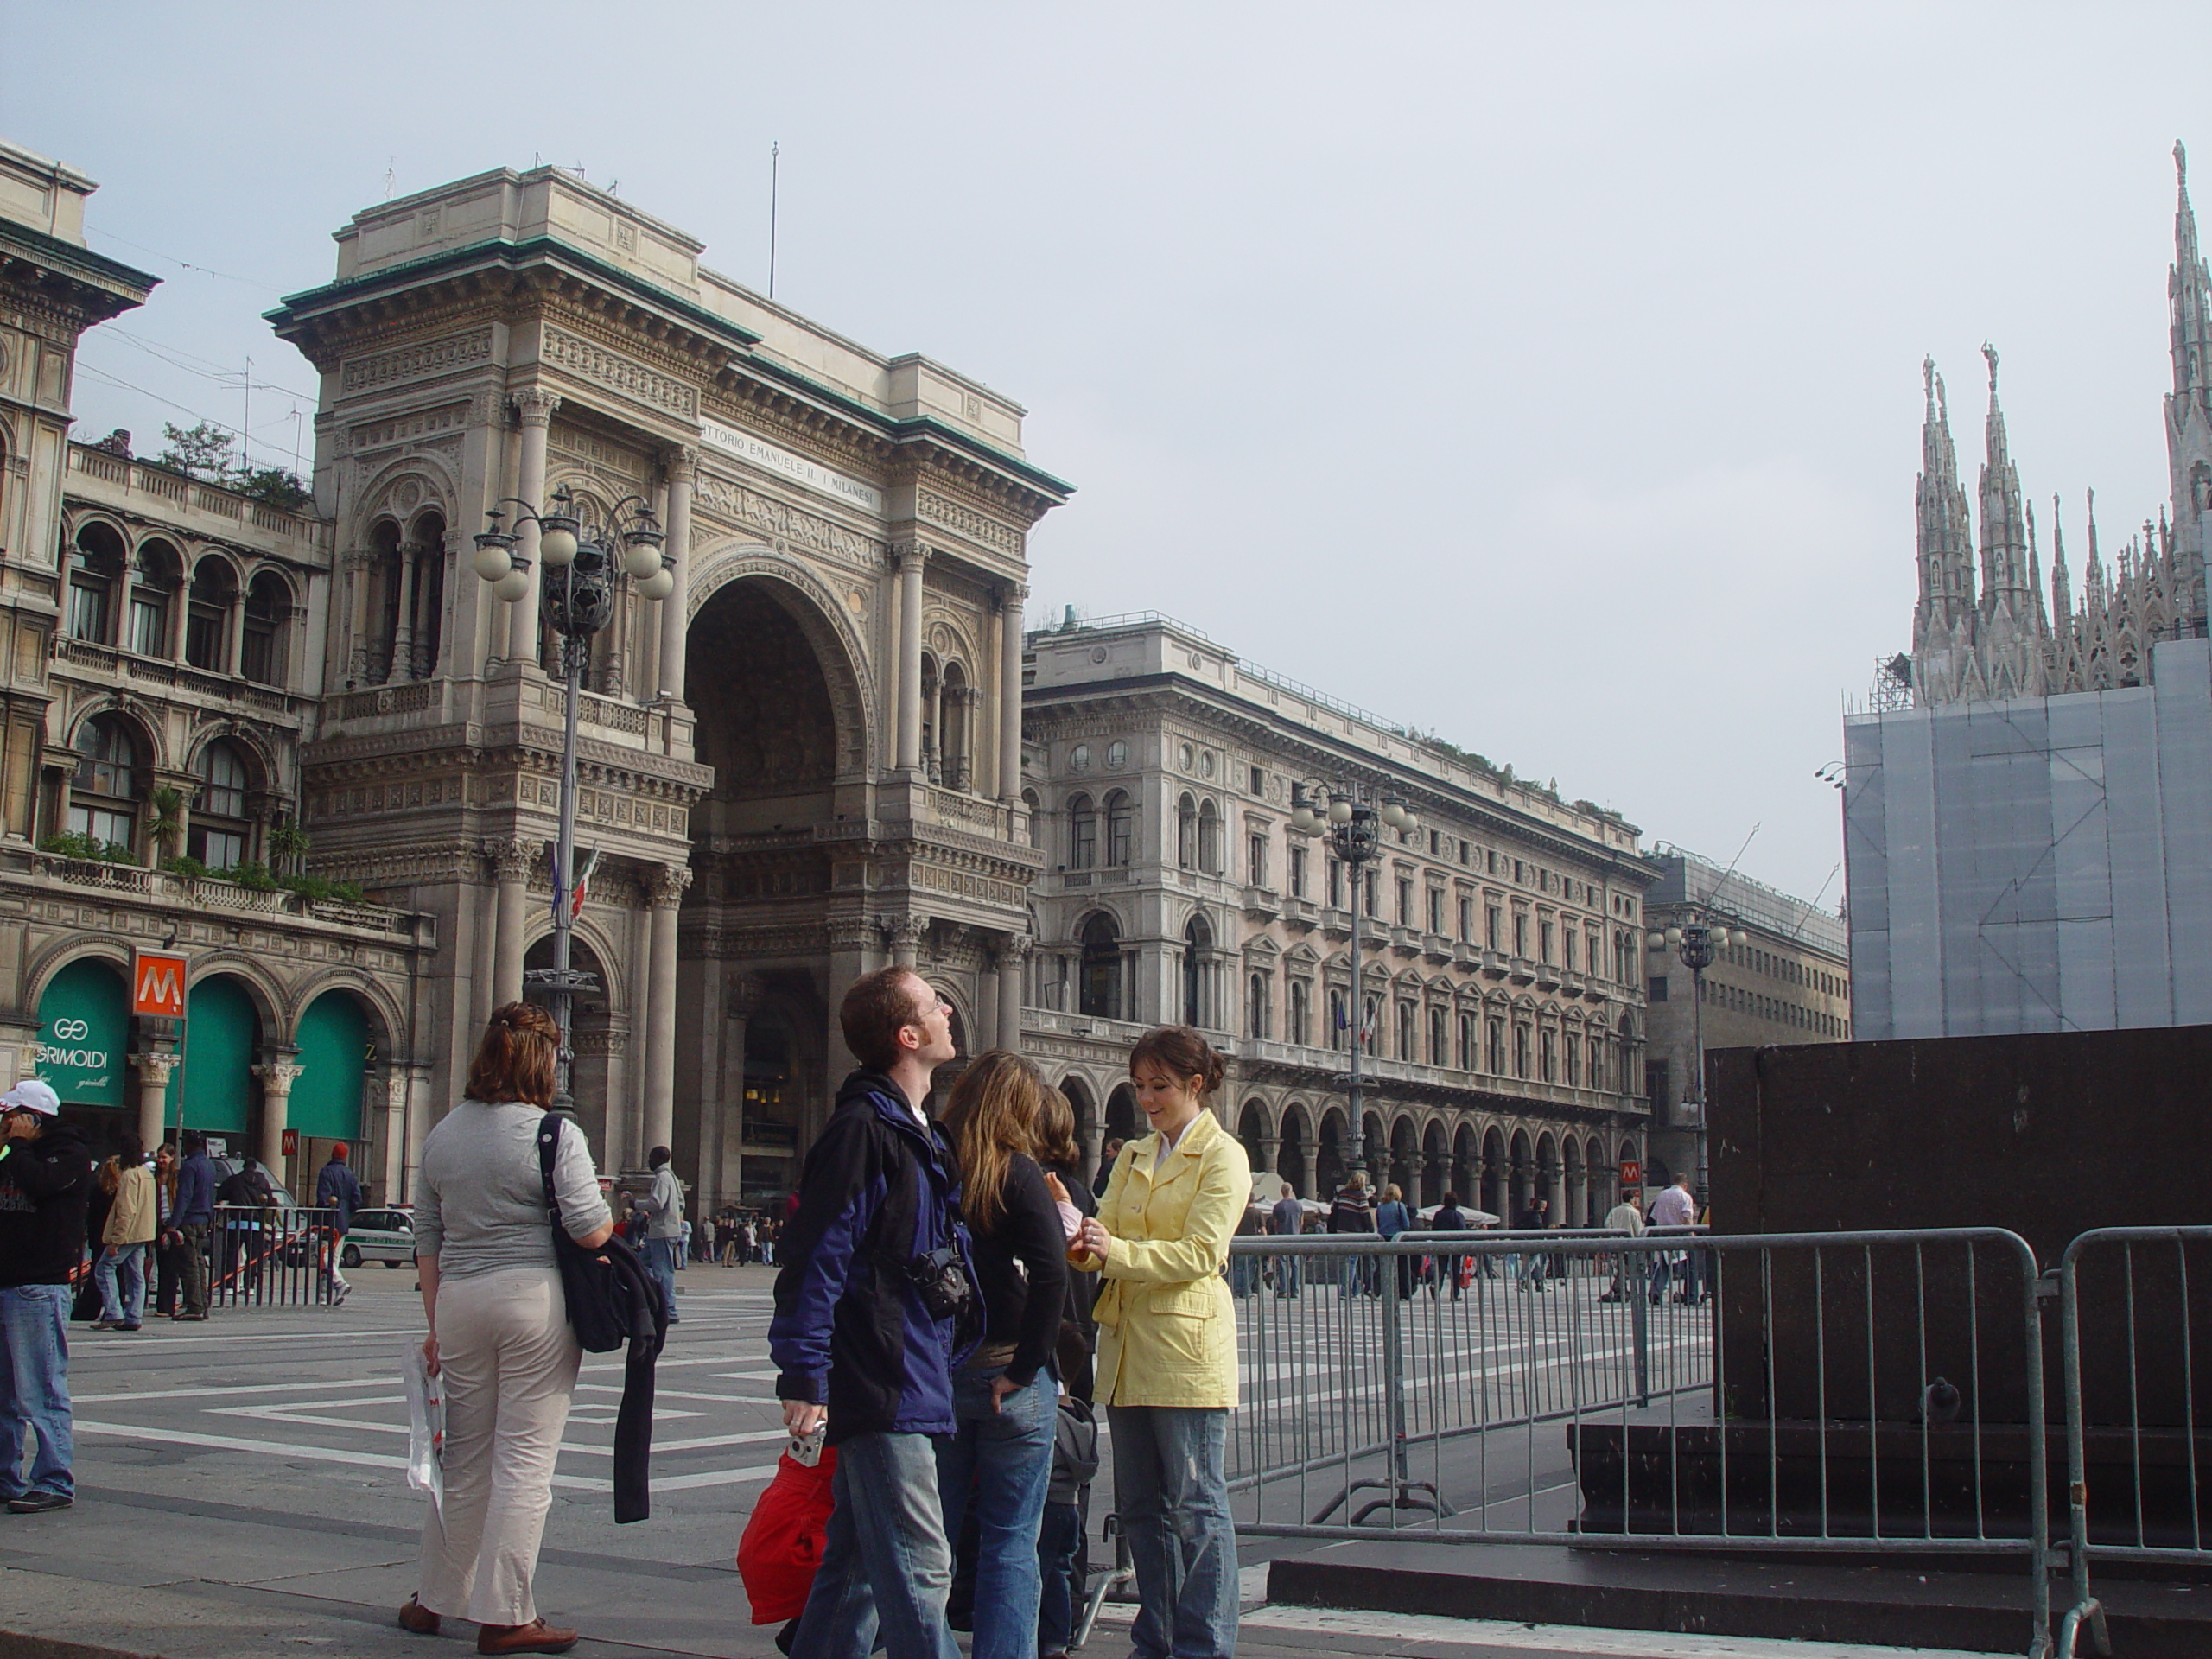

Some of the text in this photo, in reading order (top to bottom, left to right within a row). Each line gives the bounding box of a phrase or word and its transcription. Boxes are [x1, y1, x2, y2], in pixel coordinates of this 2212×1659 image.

[749, 442, 803, 475] EMANUELE
[831, 477, 874, 505] MILANESI
[138, 966, 181, 1005] M
[283, 1135, 295, 1150] M
[1624, 1166, 1638, 1178] M
